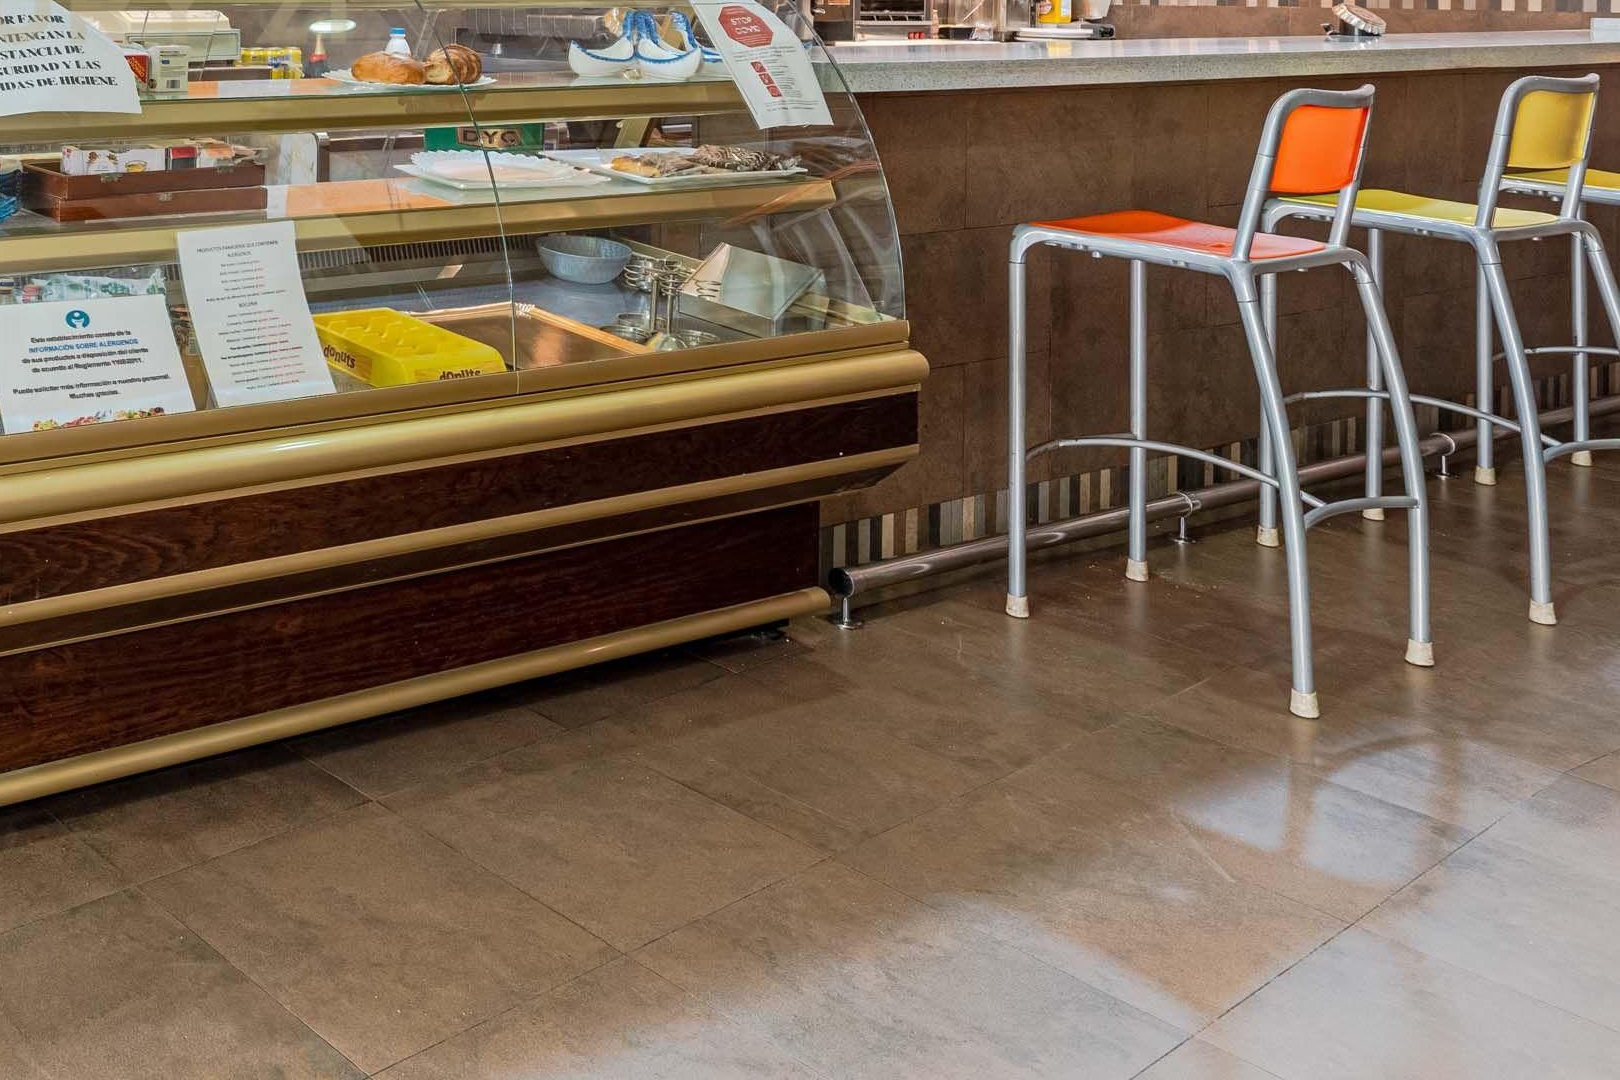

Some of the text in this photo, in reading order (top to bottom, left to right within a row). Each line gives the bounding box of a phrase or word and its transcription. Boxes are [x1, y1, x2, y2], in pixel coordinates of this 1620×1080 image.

[18, 15, 65, 26] FAVOR
[730, 17, 752, 25] STOP
[65, 45, 85, 55] DE
[63, 61, 73, 70] Y
[74, 60, 102, 70] LAS
[37, 77, 59, 88] DE
[60, 75, 118, 87] HIGIENE
[76, 341, 98, 350] SOBRE
[323, 344, 356, 369] donuts
